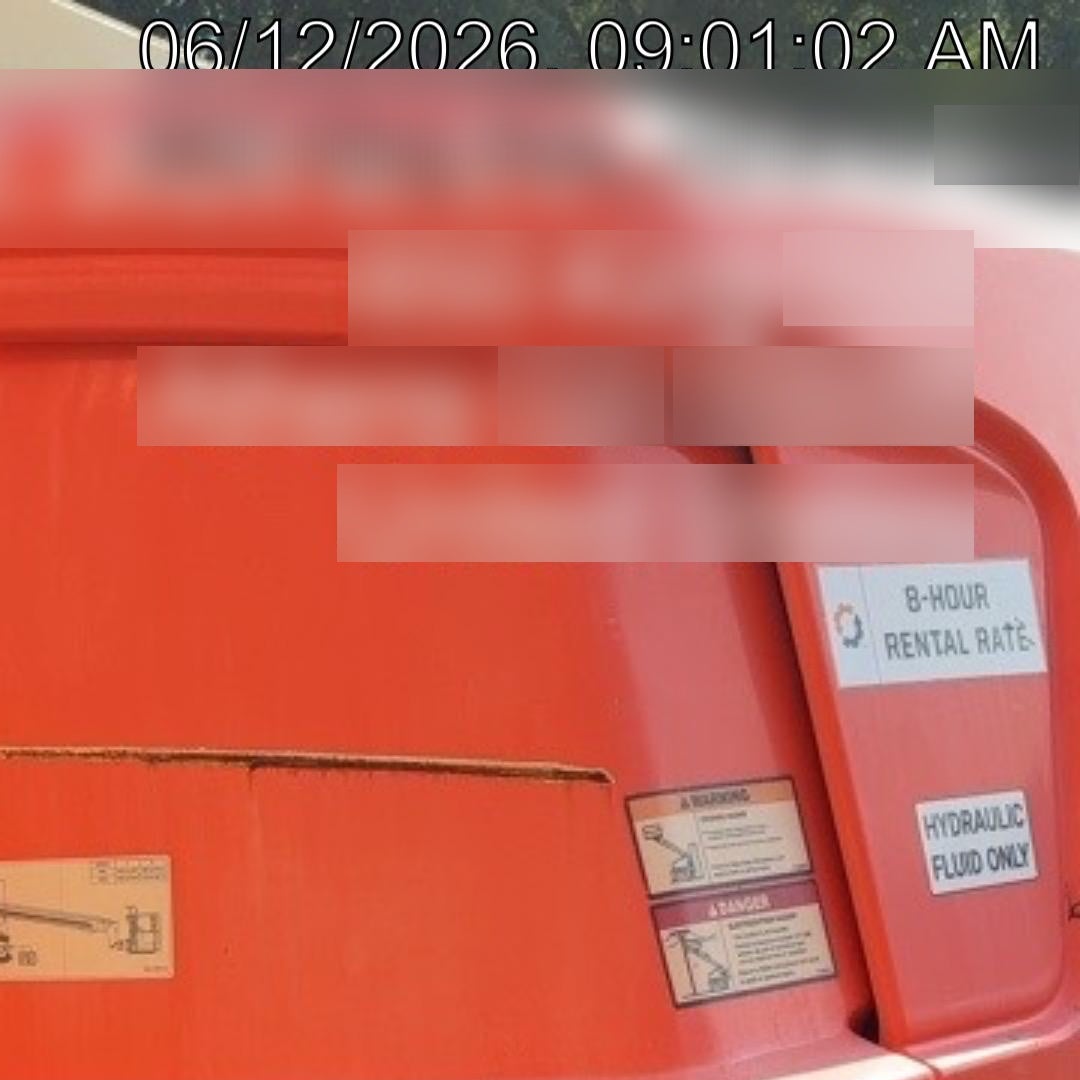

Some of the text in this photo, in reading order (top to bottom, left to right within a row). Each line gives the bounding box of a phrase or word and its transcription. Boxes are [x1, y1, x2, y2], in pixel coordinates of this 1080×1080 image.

[905, 582, 991, 613] 8-HOUR
[884, 619, 1032, 660] RENTAL RATE
[923, 803, 1024, 840] HYDRAULIC
[932, 842, 1030, 881] FLUID ONLY
